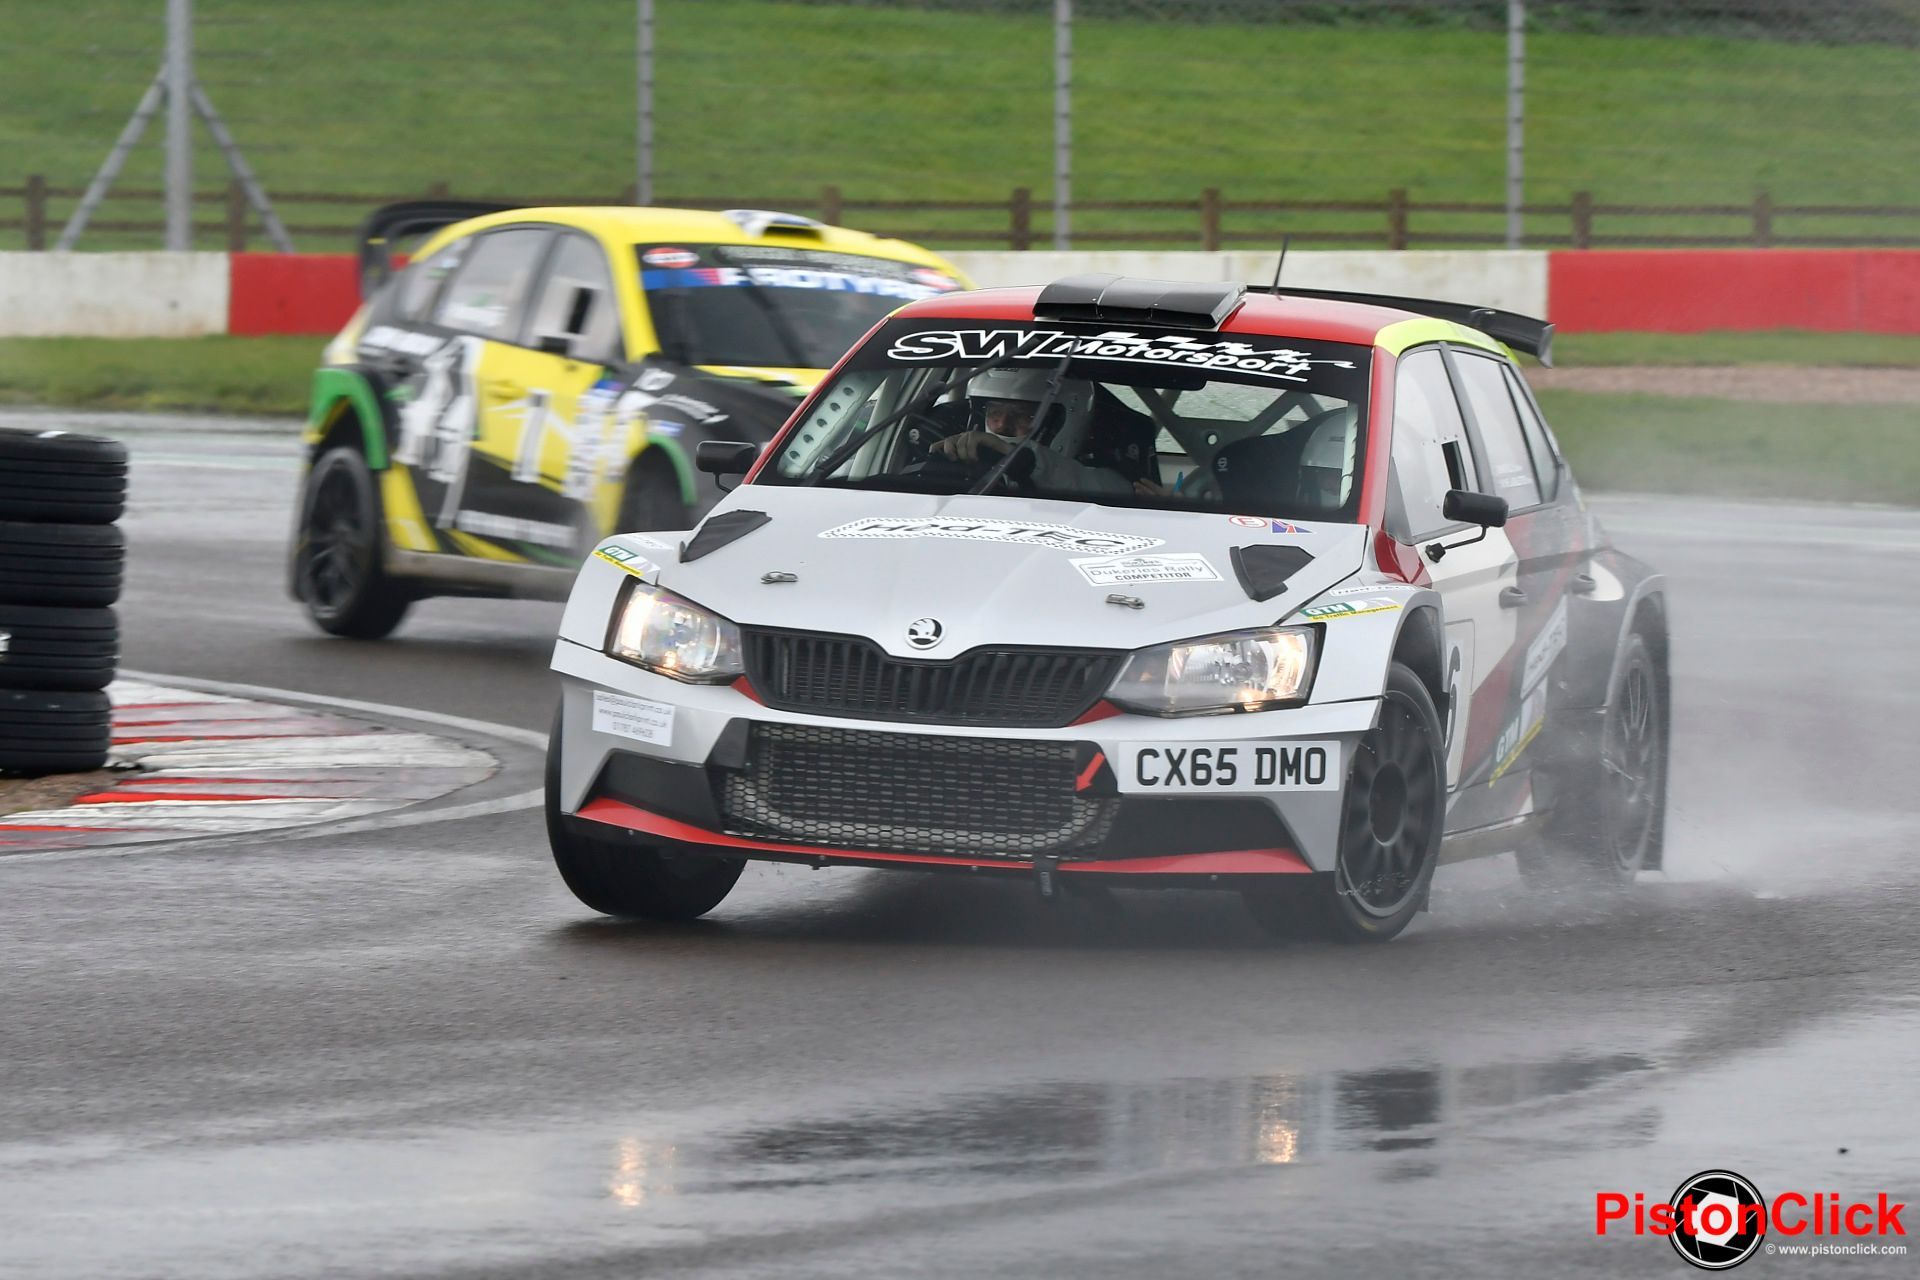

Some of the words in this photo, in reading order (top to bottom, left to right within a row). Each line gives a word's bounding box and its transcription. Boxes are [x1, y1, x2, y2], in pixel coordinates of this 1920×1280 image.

[887, 329, 1064, 360] SW
[1051, 338, 1312, 375] Motorsport
[1090, 565, 1160, 576] Dukeries
[1164, 564, 1204, 573] Rally
[1115, 572, 1192, 581] COMPETITOR
[1305, 603, 1349, 616] GTM
[1136, 748, 1238, 786] CX65
[1254, 747, 1327, 785] DMO
